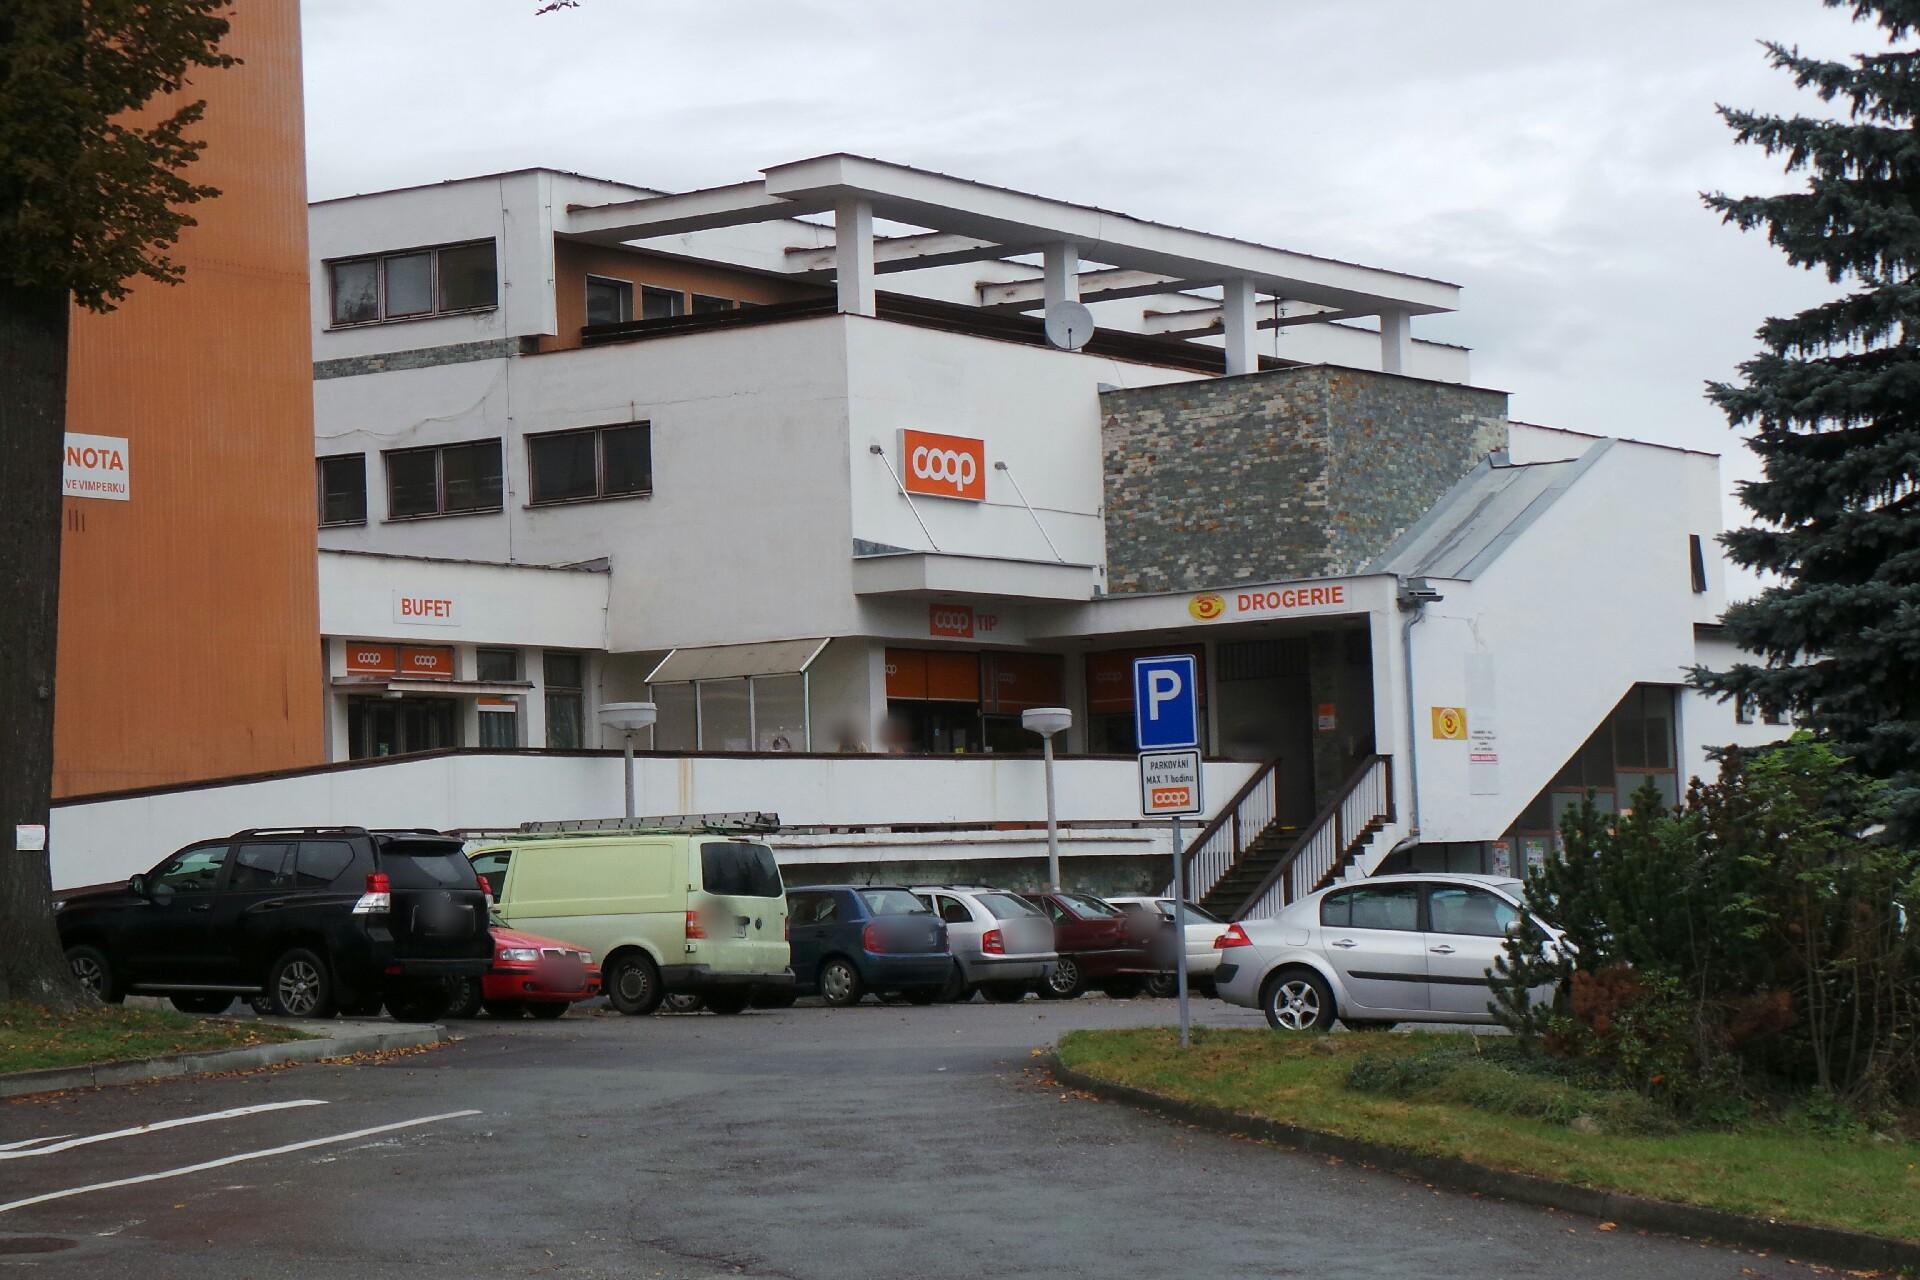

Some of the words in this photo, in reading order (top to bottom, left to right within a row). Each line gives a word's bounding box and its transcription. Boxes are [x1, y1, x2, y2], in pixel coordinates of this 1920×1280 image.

[64, 446, 124, 470] NOTA
[912, 446, 976, 491] coop
[65, 479, 77, 489] VE
[79, 480, 125, 493] VIMPERKU
[401, 598, 452, 617] BUFET
[1238, 586, 1344, 611] DROGERIE
[935, 611, 968, 633] coop
[976, 614, 999, 631] TIP
[357, 652, 381, 665] coop
[414, 655, 437, 668] coop
[1148, 669, 1182, 721] P
[1171, 774, 1194, 783] hodinu
[1154, 791, 1188, 806] coop
